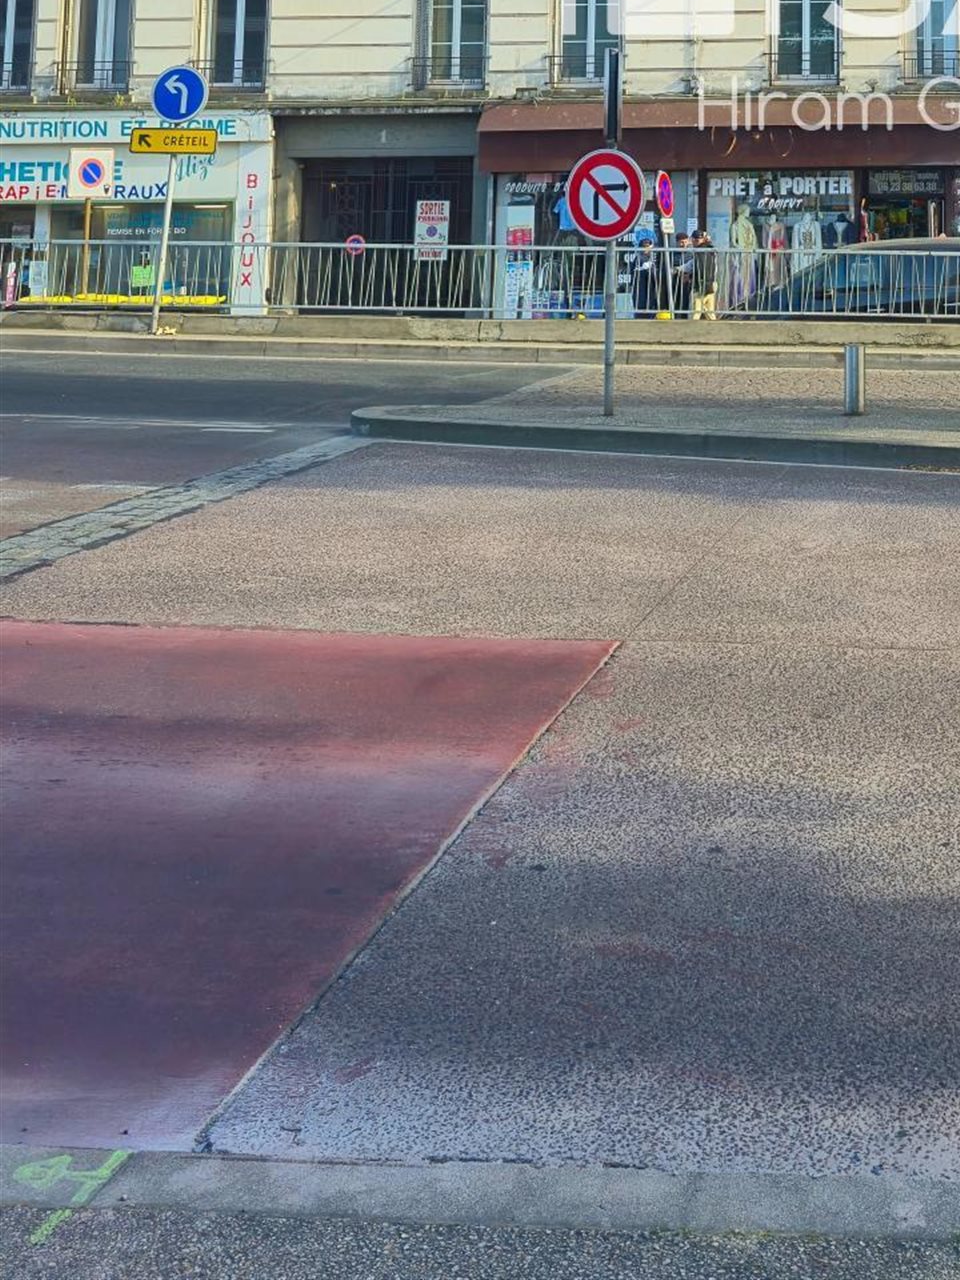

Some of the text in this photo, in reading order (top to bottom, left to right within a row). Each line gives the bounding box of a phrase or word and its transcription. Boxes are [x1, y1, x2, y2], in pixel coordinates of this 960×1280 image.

[0, 120, 107, 138] NUTRITION
[162, 133, 209, 148] CRÉTEIL
[708, 175, 759, 196] PRÊT
[763, 180, 773, 196] à
[779, 175, 852, 196] PORTER
[419, 202, 445, 216] SORTIE
